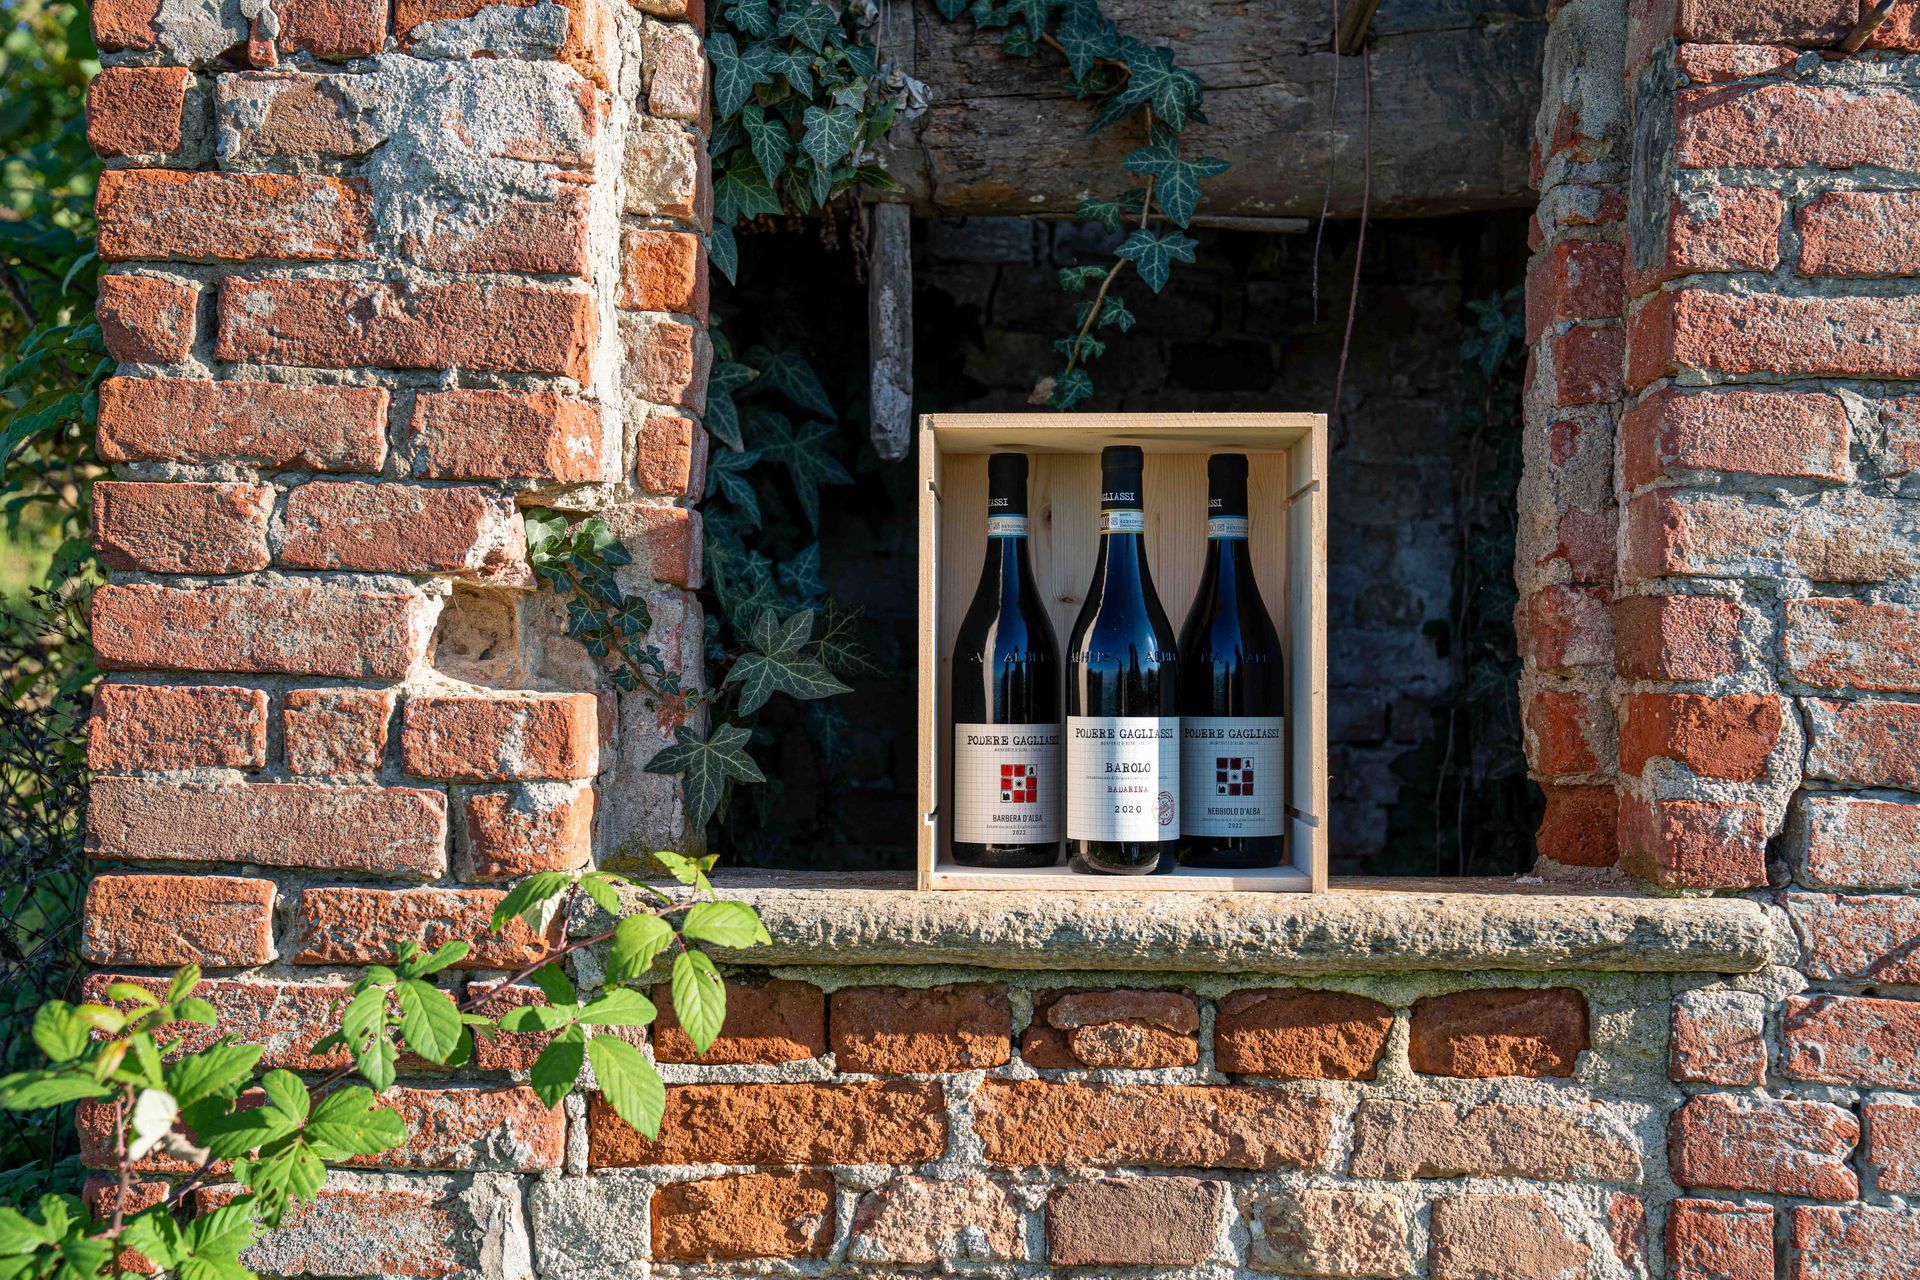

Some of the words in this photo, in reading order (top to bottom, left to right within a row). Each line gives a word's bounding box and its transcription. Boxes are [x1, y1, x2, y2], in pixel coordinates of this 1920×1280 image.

[1075, 728, 1115, 739] PODERE
[1119, 728, 1174, 739] GAGLIASSI
[1184, 728, 1225, 739] PODERE
[1228, 728, 1280, 739] GAGLIASSI
[967, 735, 1009, 746] PODERE
[1012, 735, 1060, 746] GAGLIASSI
[1104, 762, 1151, 773] BAROLO
[1107, 785, 1149, 793] BADARINA
[1114, 805, 1142, 814] 2020
[1207, 807, 1239, 816] NEBBIOLO
[1239, 807, 1261, 816] D'ALBA
[992, 814, 1022, 823] BARBERA
[1022, 814, 1043, 822] D'ALBA
